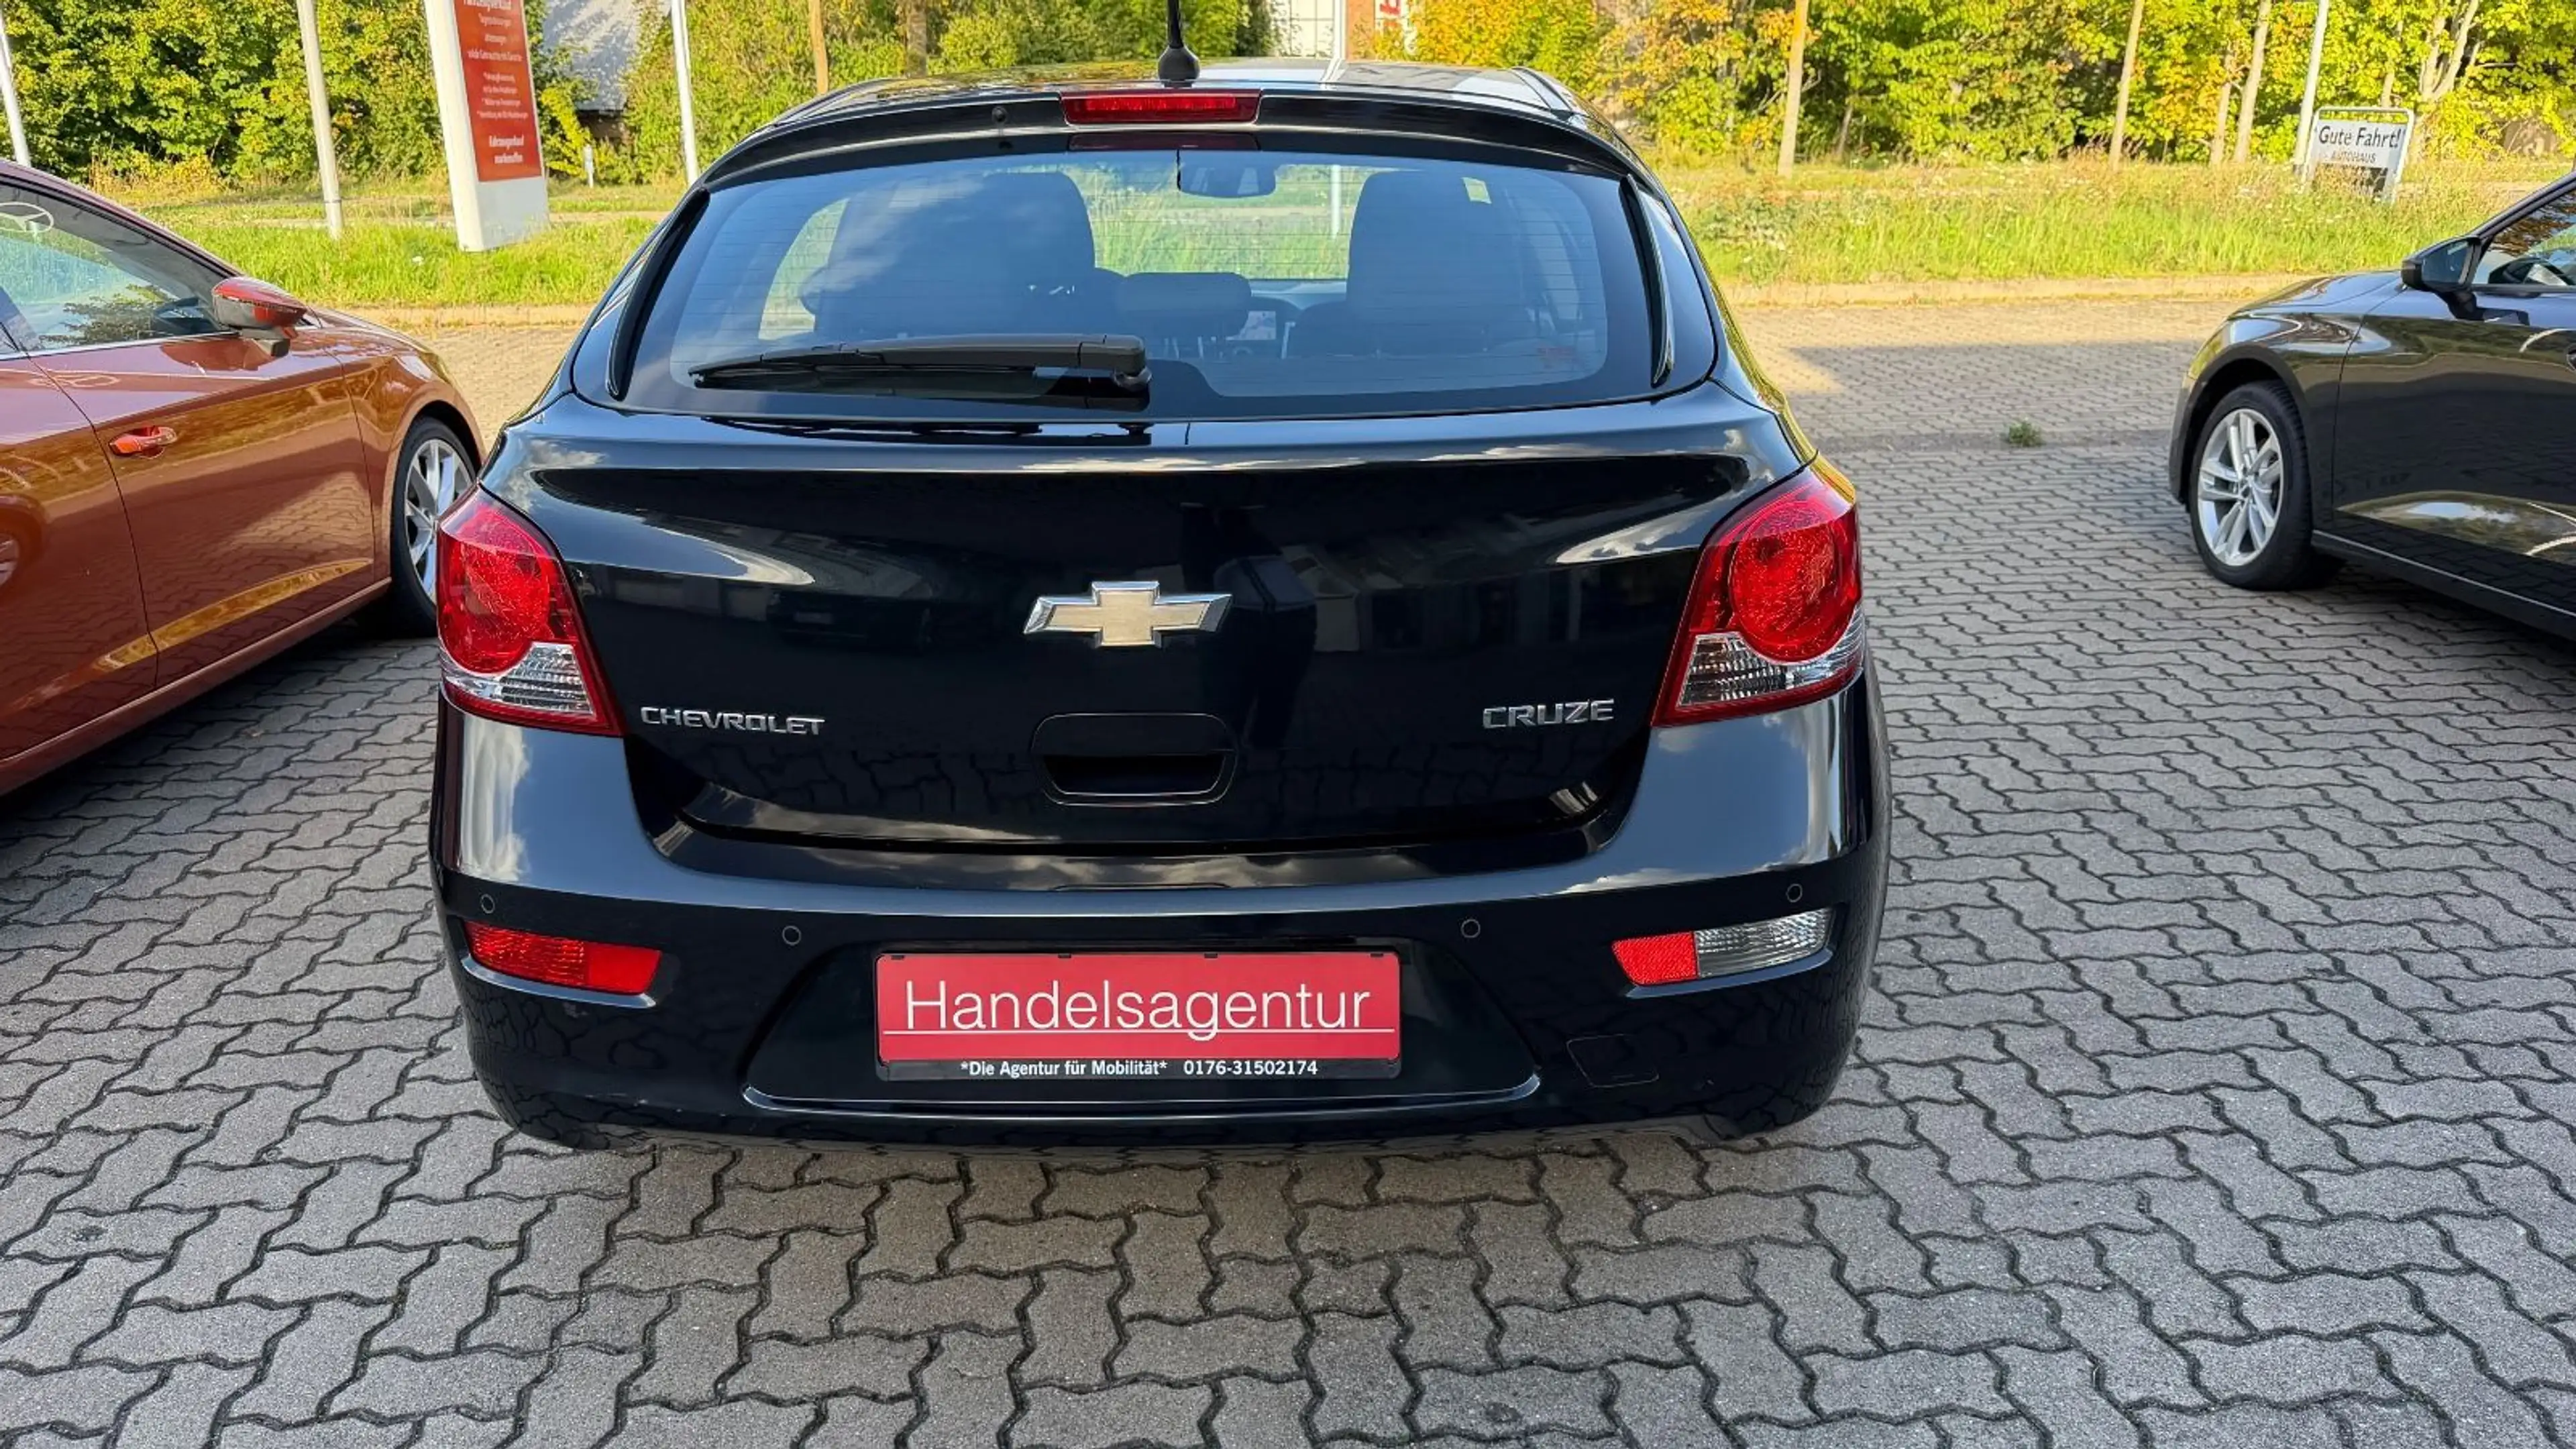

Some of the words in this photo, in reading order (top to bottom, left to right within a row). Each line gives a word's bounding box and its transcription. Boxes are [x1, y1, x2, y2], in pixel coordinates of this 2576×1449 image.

[2318, 125, 2352, 145] Gute
[2355, 127, 2402, 148] Fahrt!
[2330, 150, 2377, 163] AUTOHAUS
[640, 706, 825, 735] CHEVROLET
[1483, 698, 1614, 729] CRUZE
[906, 979, 1370, 1042] Handelsagentur
[1000, 1060, 1062, 1078] Agentur
[1063, 1059, 1087, 1075] für
[1183, 1060, 1318, 1075] 0176-31502174
